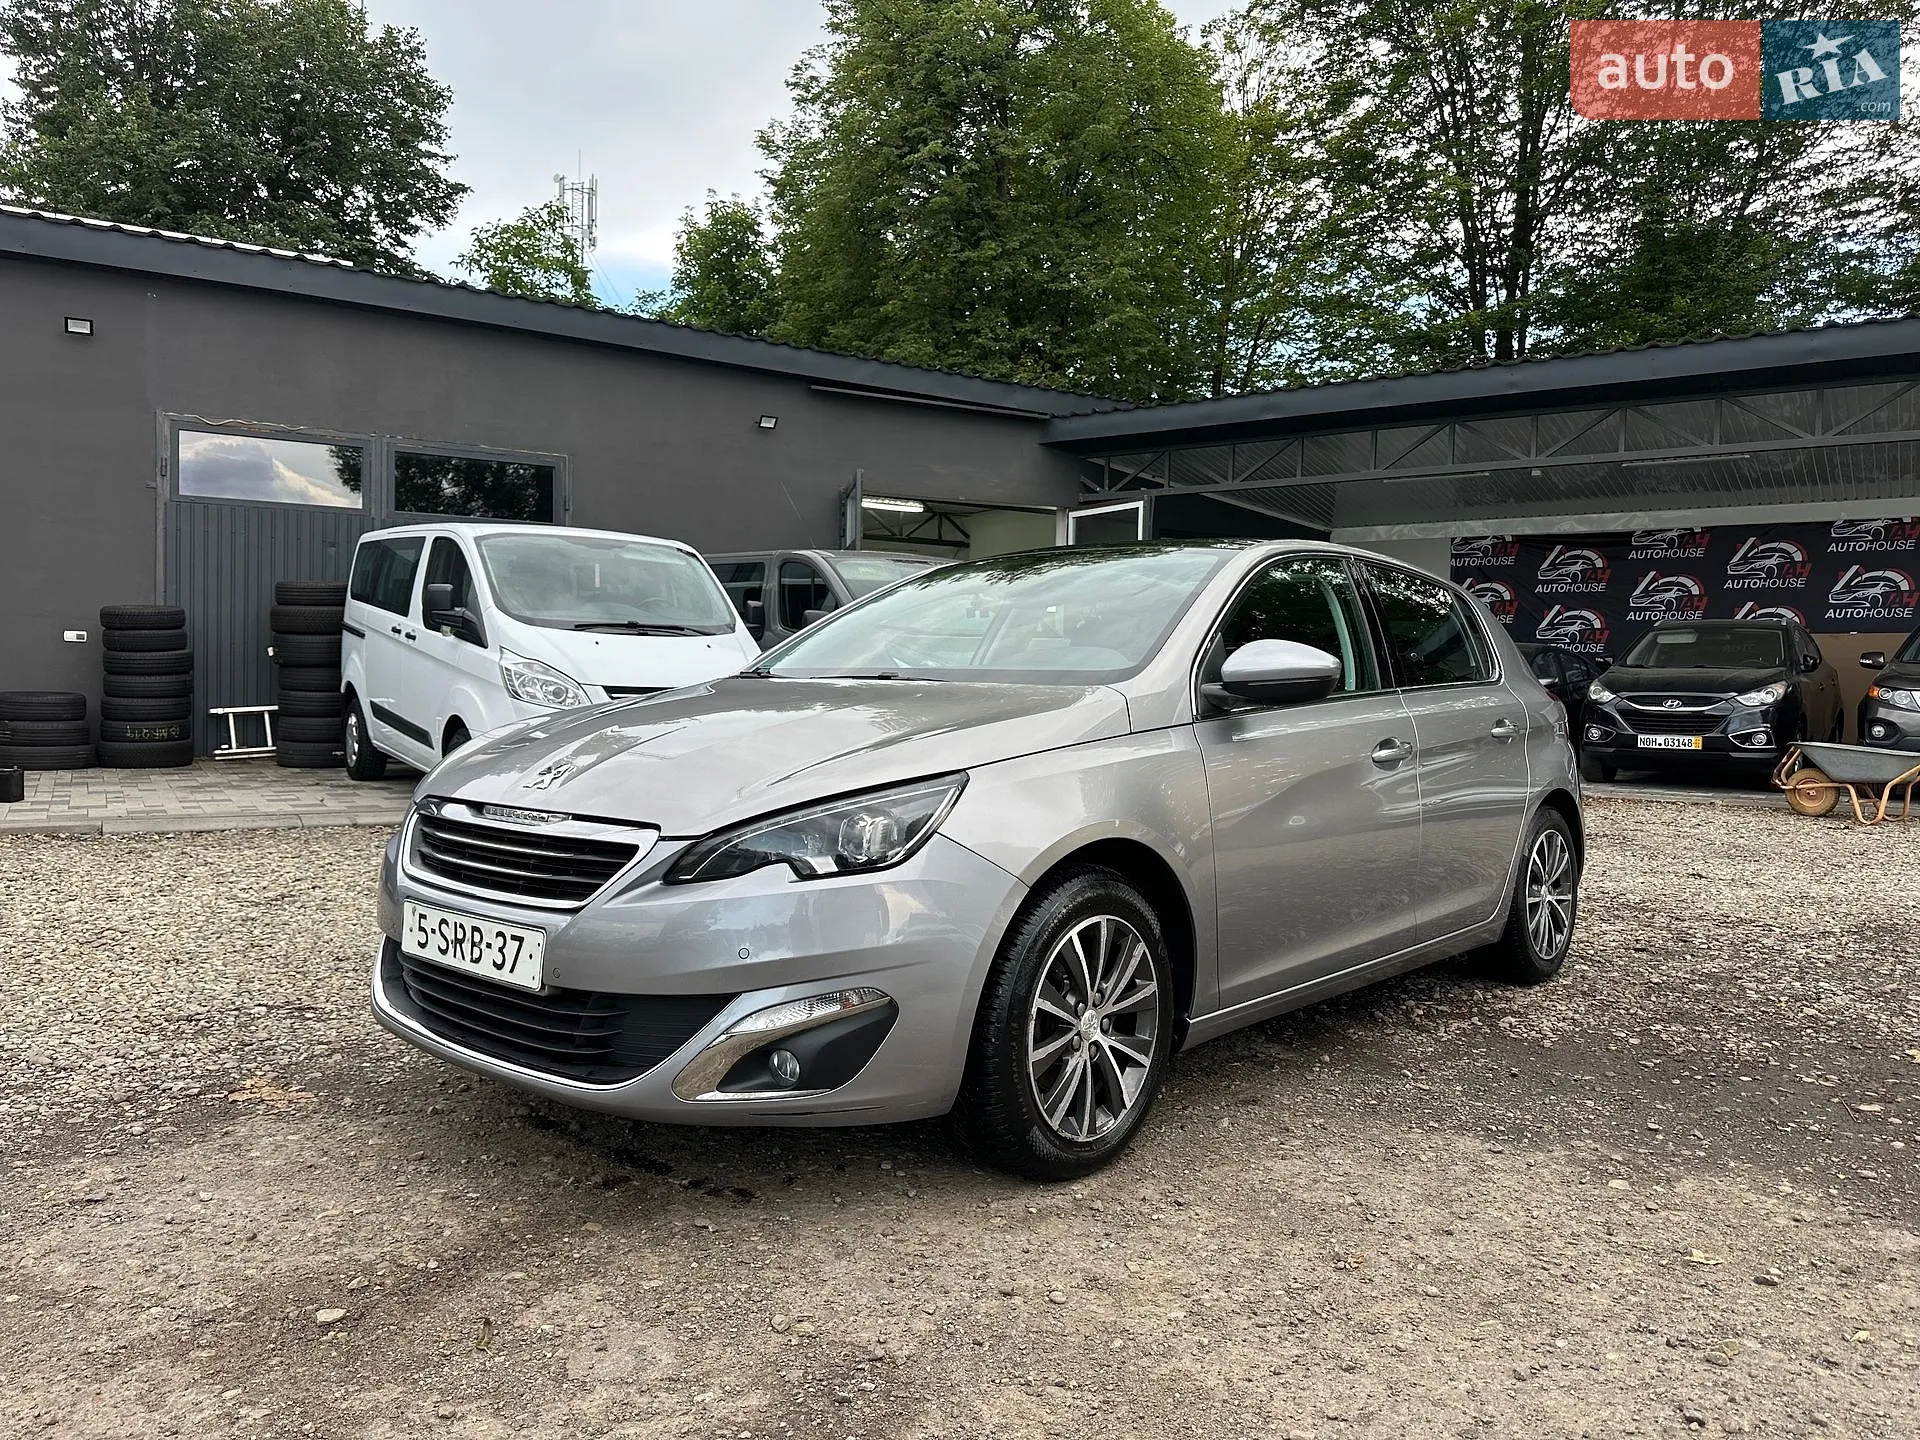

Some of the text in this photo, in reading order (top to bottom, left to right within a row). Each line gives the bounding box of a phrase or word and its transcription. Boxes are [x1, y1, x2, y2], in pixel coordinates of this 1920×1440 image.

[1827, 540, 1916, 552] AUTOHOUSE
[1628, 548, 1706, 559] AUTOHOUSE
[1450, 556, 1516, 567] AUTOHOUSE
[1535, 583, 1607, 593] AUTOHOUSE
[1723, 577, 1807, 589] AUTOHOUSE
[1626, 611, 1704, 621] AUTOHOUSE
[1825, 607, 1915, 619] AUTOHOUSE
[1550, 643, 1605, 653] HOUSE
